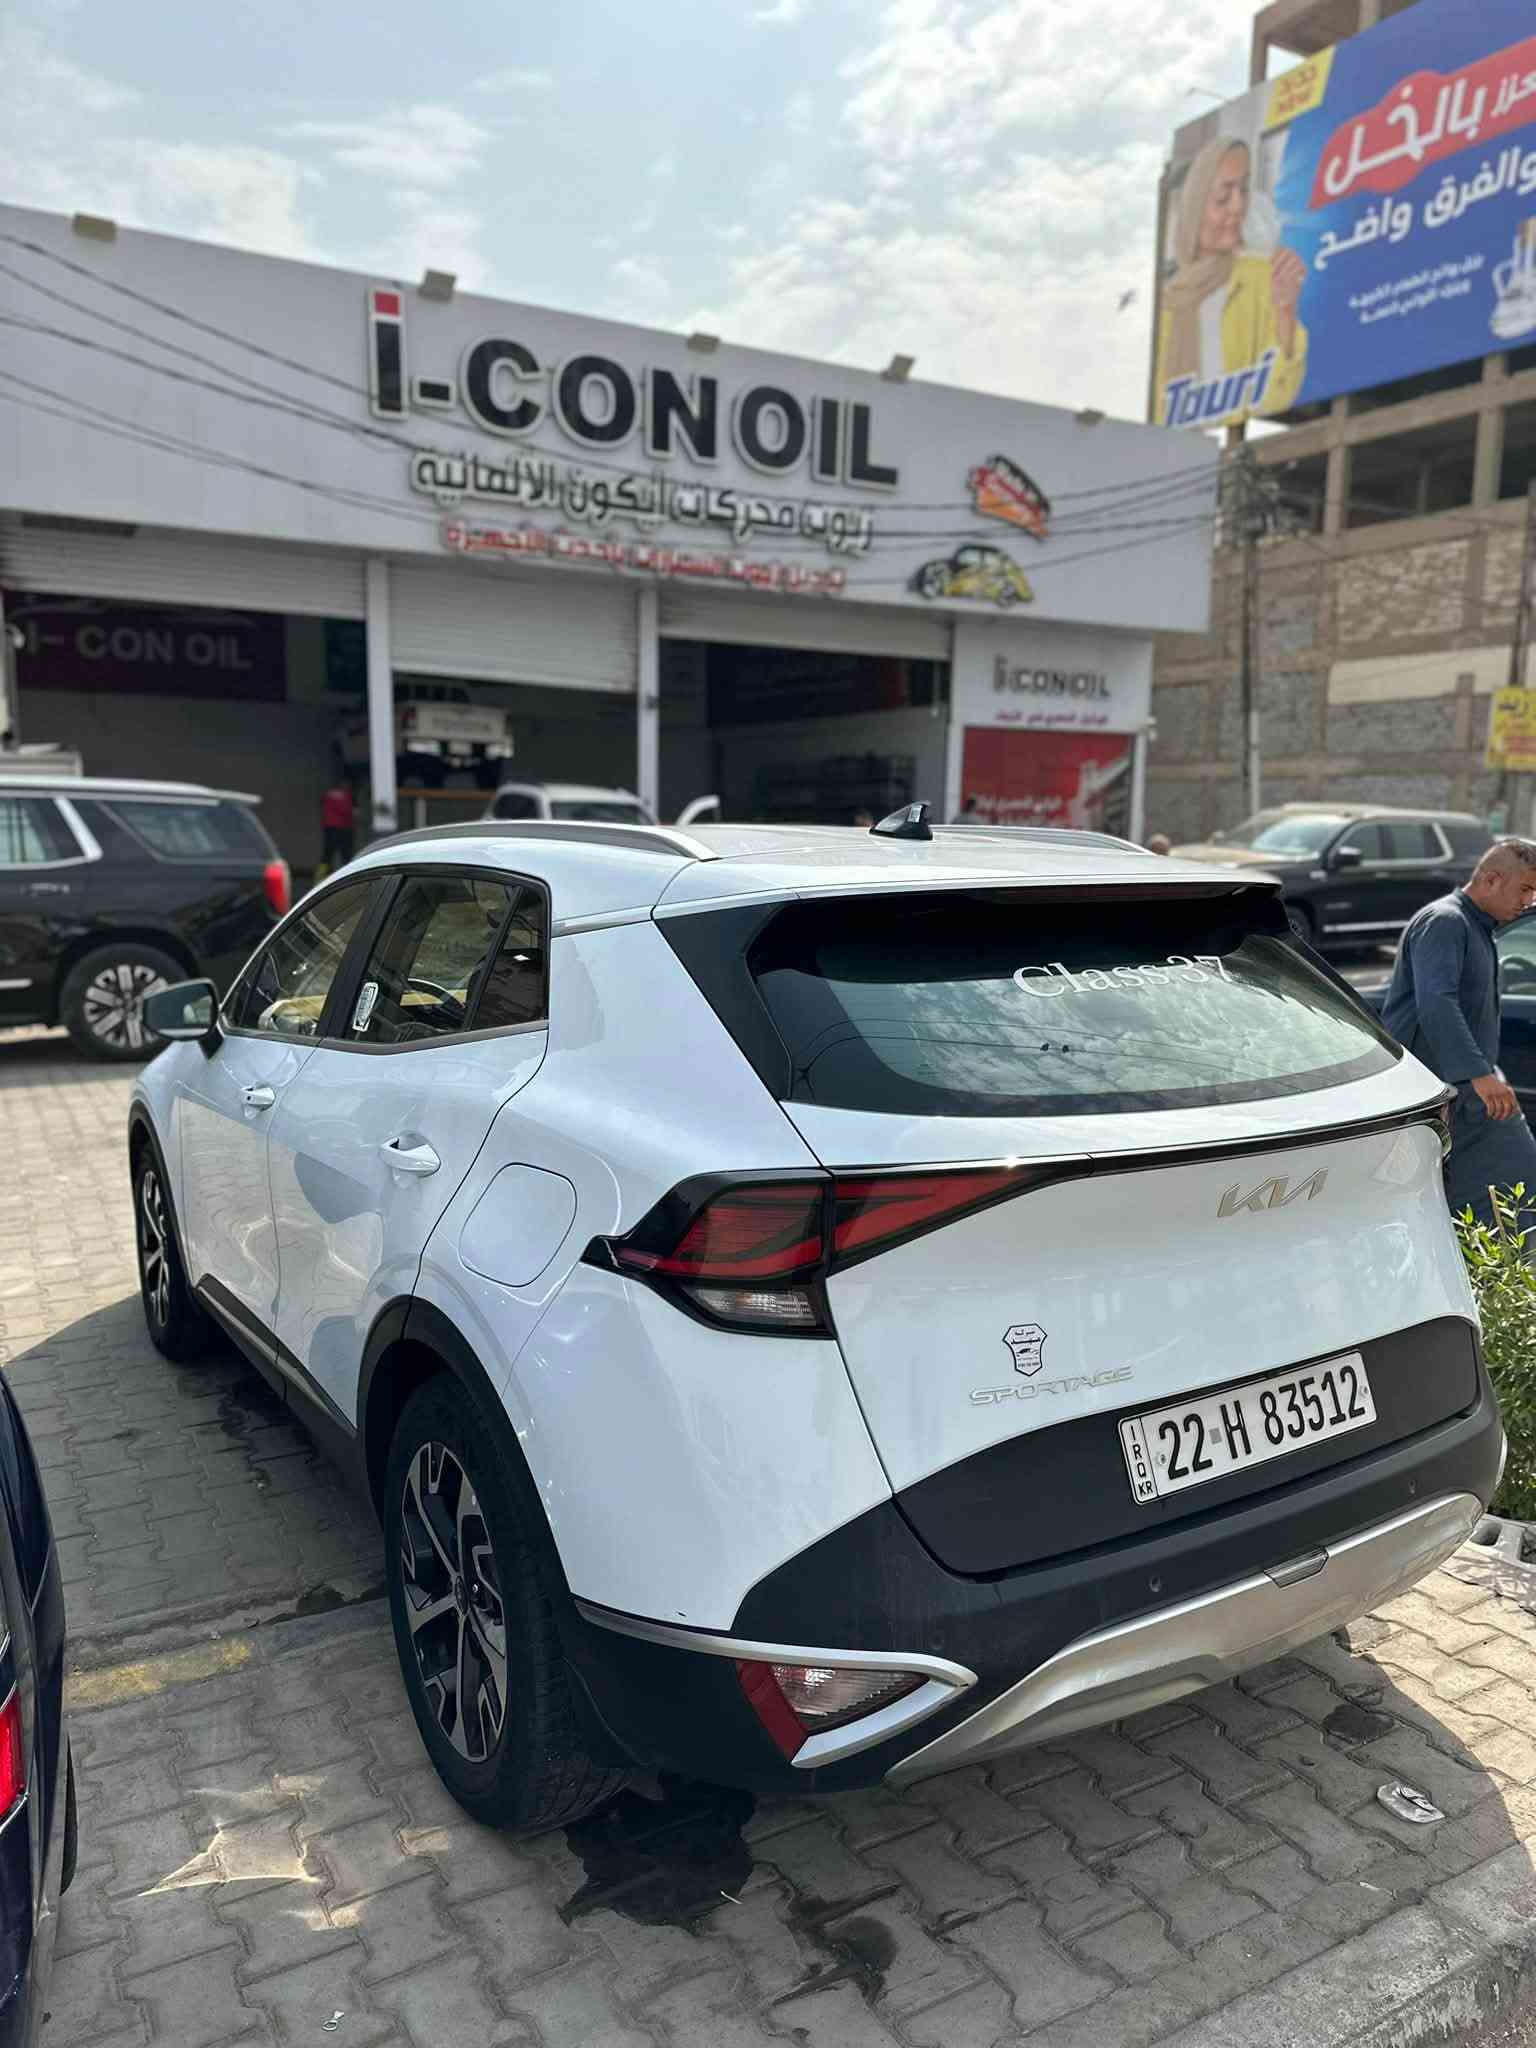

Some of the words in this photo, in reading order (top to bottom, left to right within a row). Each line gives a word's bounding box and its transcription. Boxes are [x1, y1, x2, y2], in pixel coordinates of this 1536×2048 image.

[1323, 77, 1488, 196] بالخل
[1423, 145, 1536, 229] والفرق
[1314, 196, 1413, 270] واضح
[1166, 349, 1276, 427] Touri
[737, 384, 899, 488] OIL
[678, 482, 797, 537] محركات
[184, 632, 254, 671] OIL
[969, 1364, 1137, 1407] SPORTAGE
[1158, 1412, 1213, 1480] 22
[1219, 1399, 1252, 1460] H
[1259, 1365, 1366, 1446] 83512
[1137, 1479, 1154, 1498] KR
